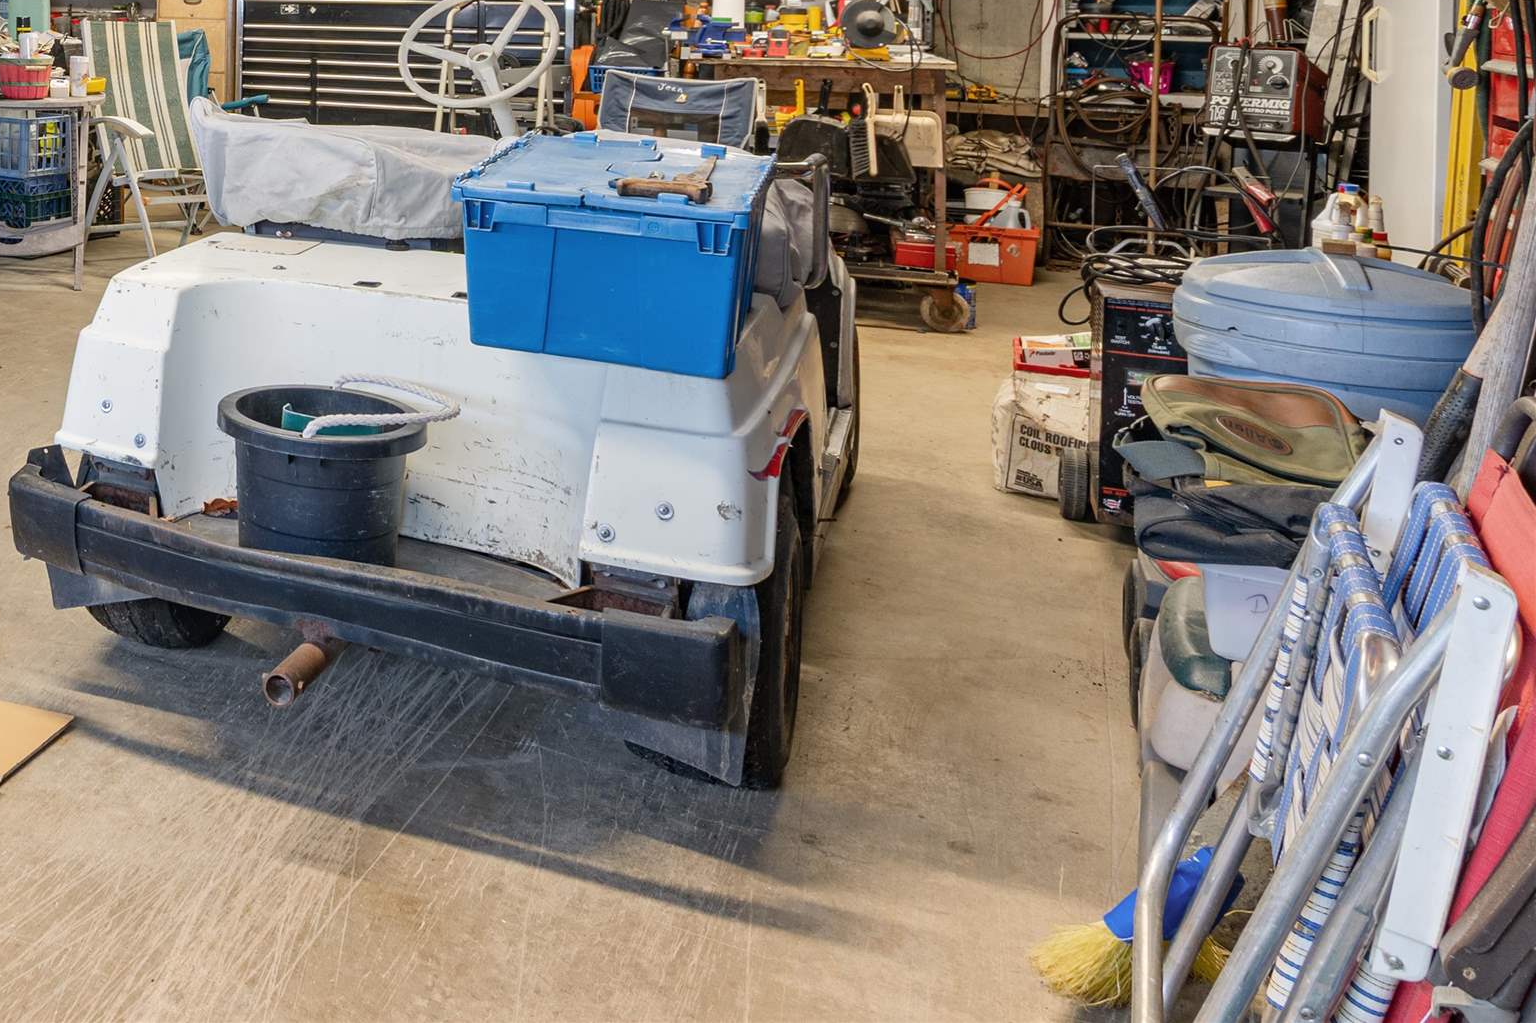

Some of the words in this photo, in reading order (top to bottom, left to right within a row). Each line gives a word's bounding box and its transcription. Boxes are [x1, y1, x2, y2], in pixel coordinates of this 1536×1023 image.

[1210, 96, 1292, 110] POERMIG
[1018, 435, 1052, 456] CLOUS
[1020, 424, 1042, 441] COIL
[1045, 431, 1088, 451] ROOFIN
